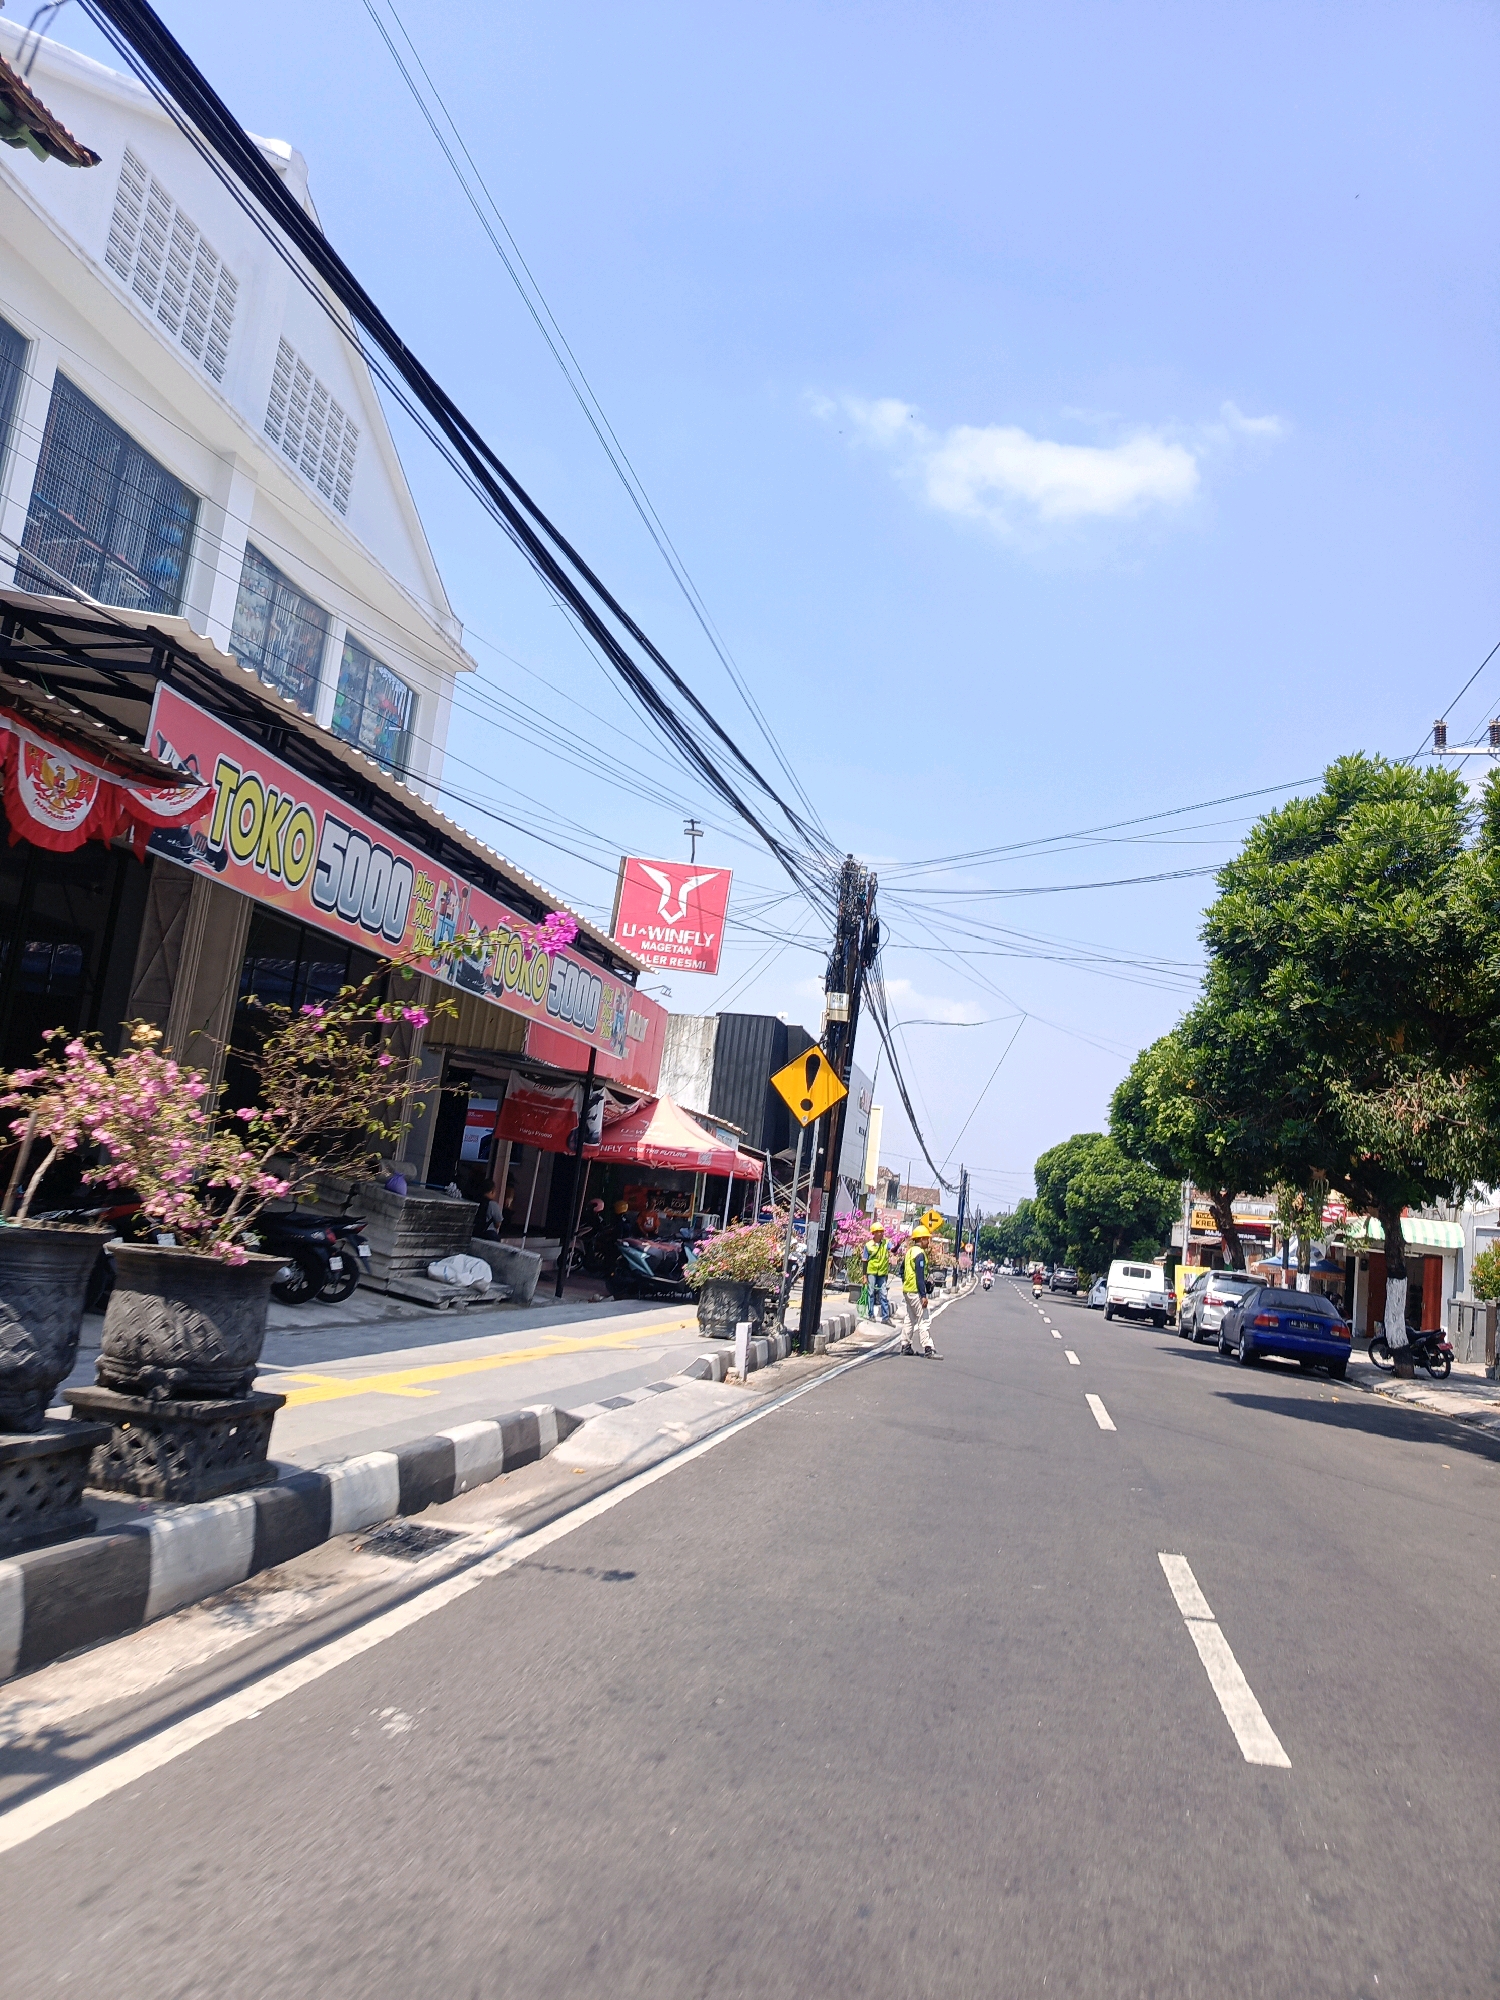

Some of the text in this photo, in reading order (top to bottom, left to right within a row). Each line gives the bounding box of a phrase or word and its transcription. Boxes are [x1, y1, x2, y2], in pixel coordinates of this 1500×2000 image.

[210, 757, 414, 945] TOKO 5000
[413, 872, 436, 903] Plus
[412, 898, 434, 929] Plus
[638, 952, 707, 969] ALER RESMI
[641, 940, 693, 956] MAGETAN
[493, 925, 549, 1003] TOKO
[546, 954, 603, 1034] 5000
[600, 1144, 623, 1153] NFLY
